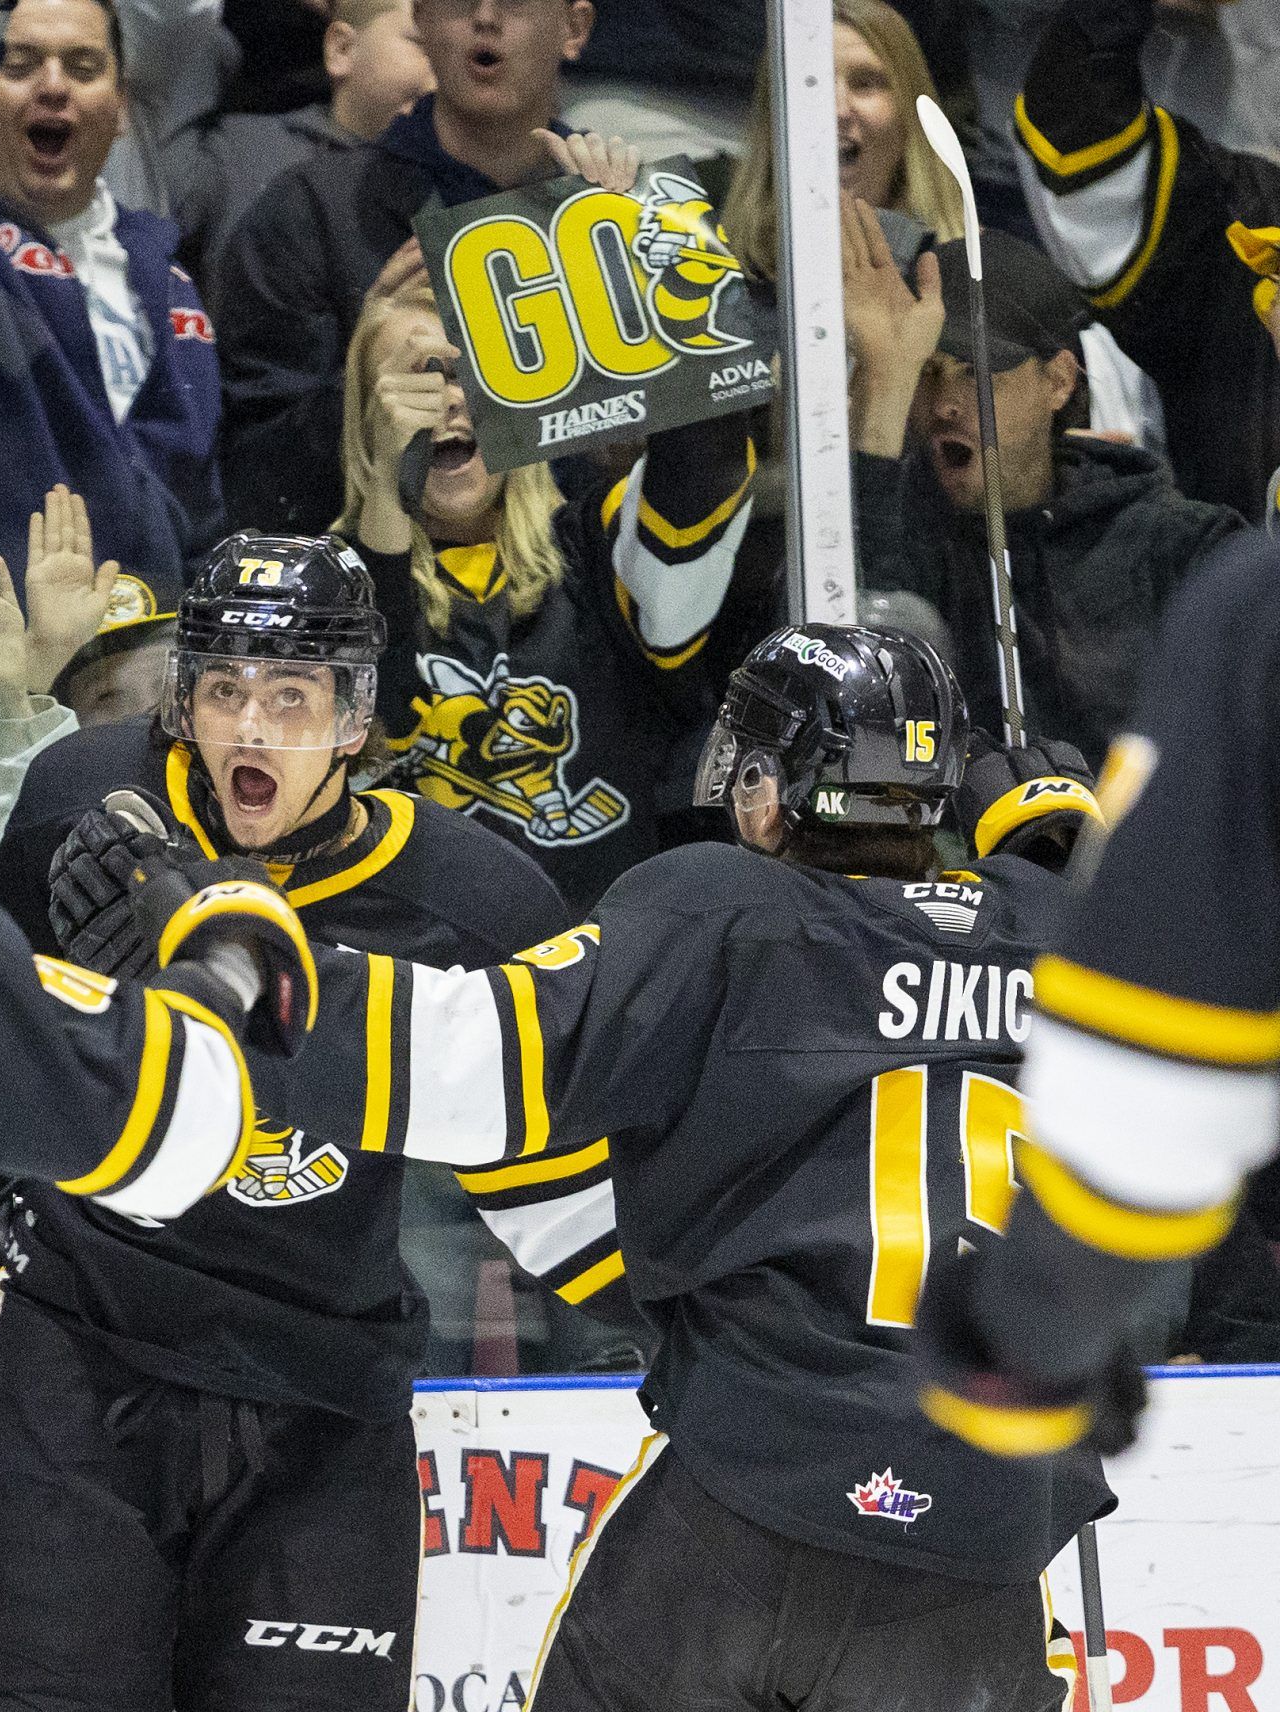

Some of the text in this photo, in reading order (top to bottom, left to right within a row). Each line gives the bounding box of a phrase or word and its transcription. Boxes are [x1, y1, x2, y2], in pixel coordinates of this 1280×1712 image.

[444, 187, 680, 409] GO
[537, 389, 647, 447] HAINES
[239, 557, 284, 586] 73
[221, 609, 293, 628] CCM
[905, 721, 935, 763] 15
[816, 790, 844, 815] AK
[902, 881, 983, 905] CCM
[878, 960, 1035, 1043] SIKIC
[878, 1490, 917, 1518] CHL
[244, 1618, 397, 1661] CCM
